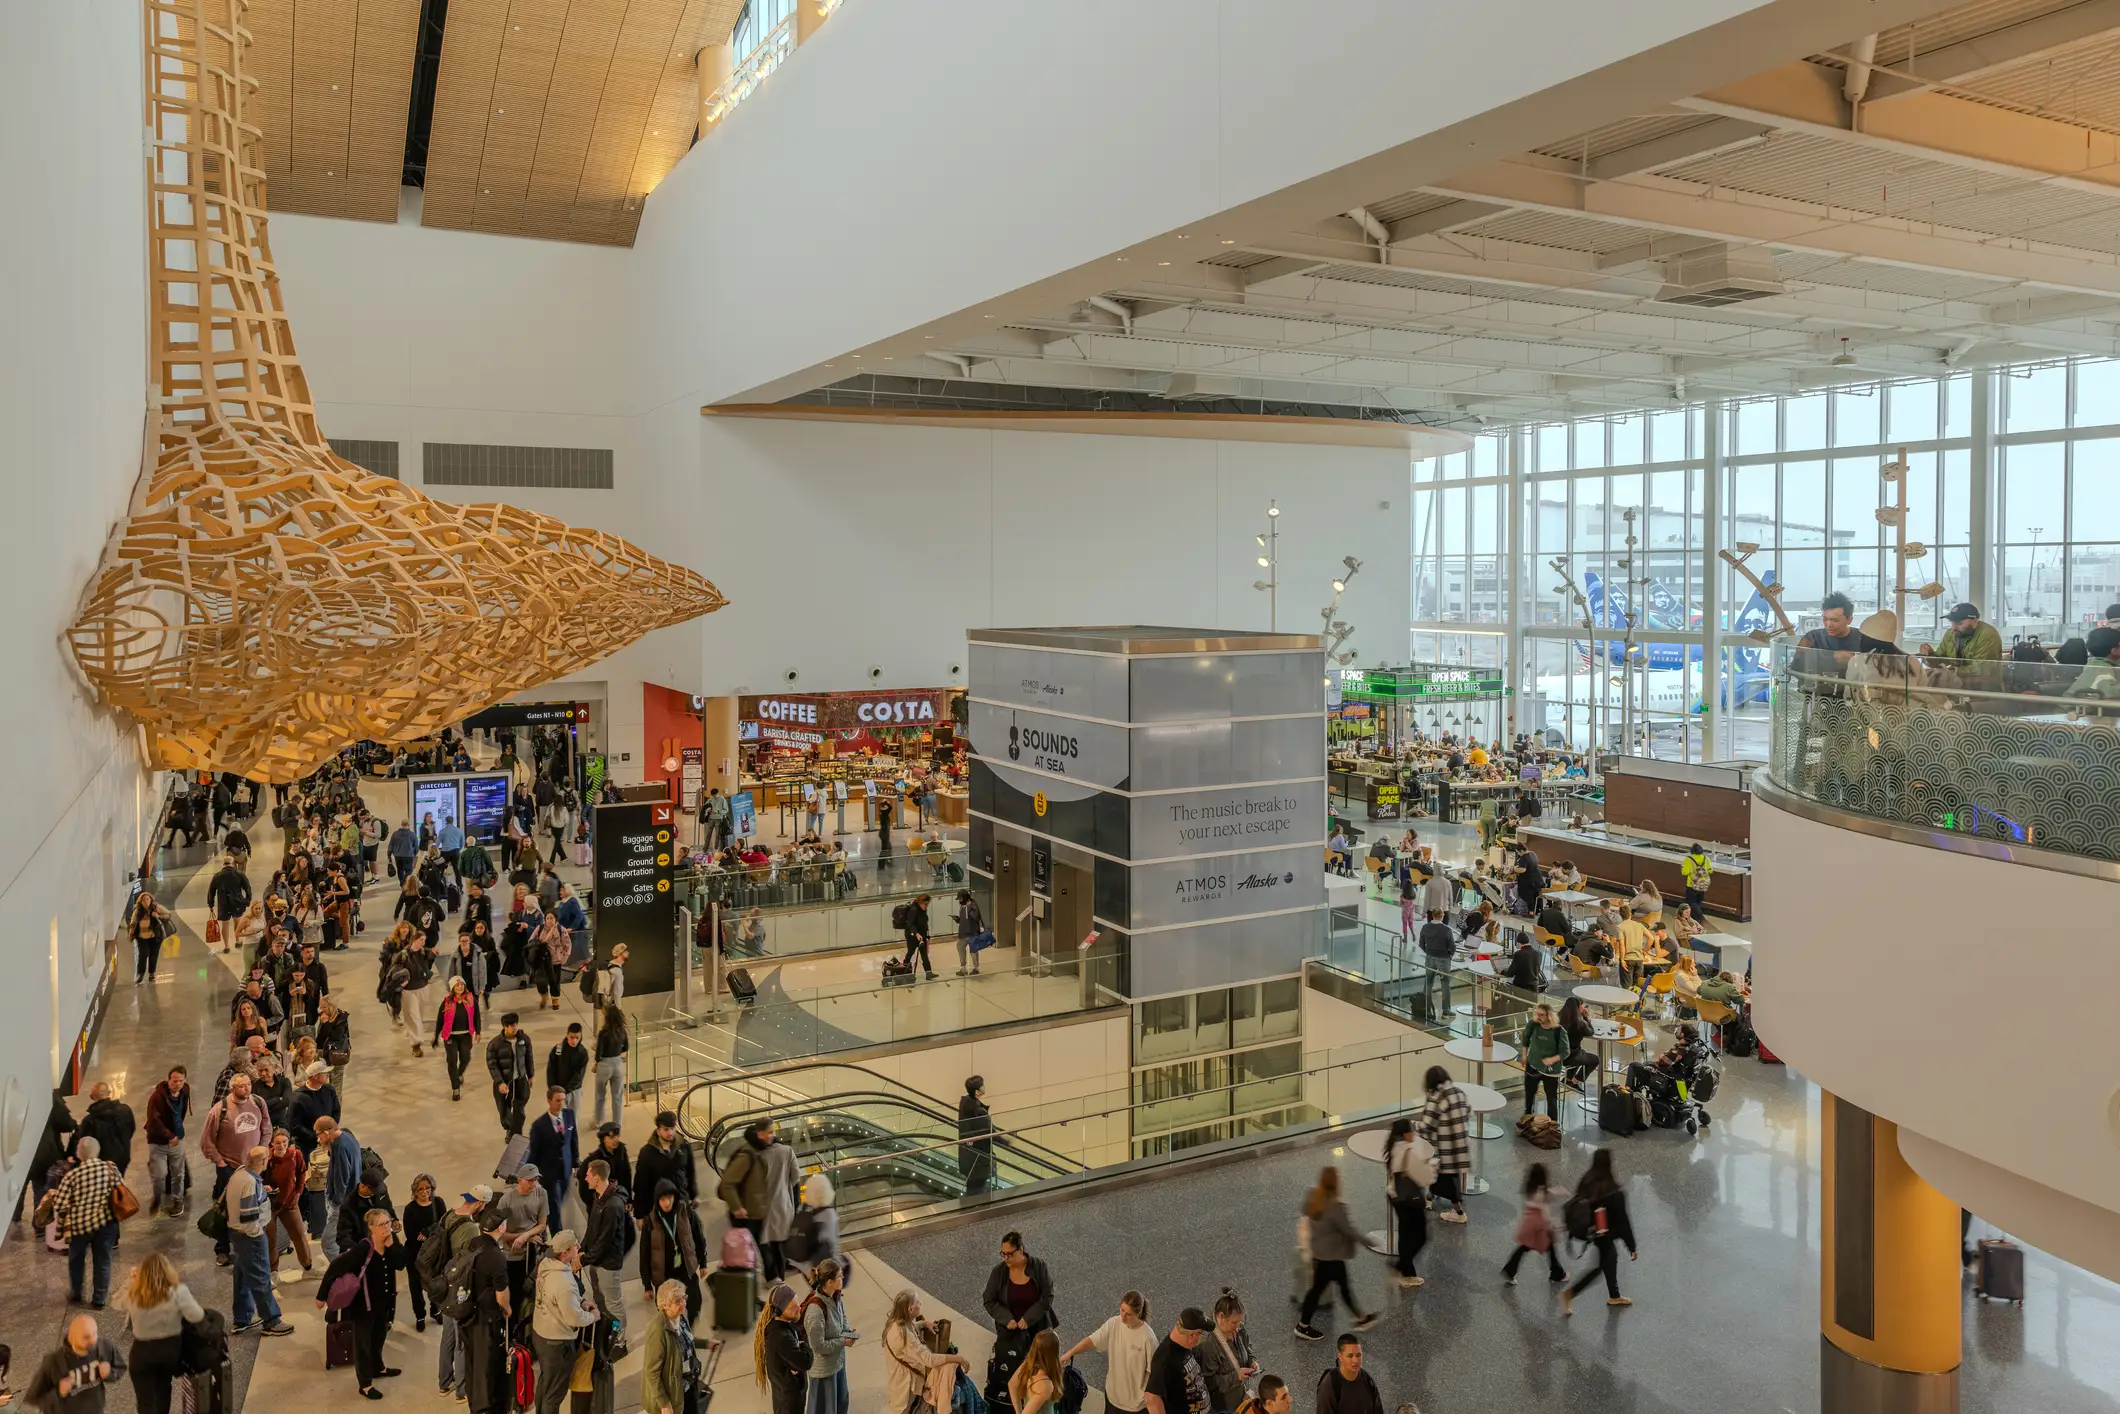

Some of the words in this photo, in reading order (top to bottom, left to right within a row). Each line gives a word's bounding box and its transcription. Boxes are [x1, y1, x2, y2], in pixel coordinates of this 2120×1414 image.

[1346, 670, 1364, 682] SPACE
[1431, 671, 1449, 683] OPEN
[1450, 671, 1470, 682] SPACE
[1021, 679, 1039, 689] ATMOS
[1042, 684, 1058, 694] Alaska
[1357, 683, 1372, 692] BITES
[1423, 684, 1441, 693] FRESH
[1442, 683, 1457, 692] BEER
[1458, 683, 1463, 691] &
[1464, 682, 1480, 691] BITES
[759, 699, 817, 723] COFFEE
[857, 700, 934, 722] COSTA
[763, 728, 789, 739] BARISTA
[790, 731, 822, 743] CRAFTED
[774, 739, 791, 748] DRINKS
[1023, 728, 1078, 758] SOUNDS
[1034, 756, 1044, 768] AT
[1047, 758, 1065, 773] SEA
[1379, 786, 1398, 794] OPEN
[1377, 795, 1399, 804] SPACE
[1170, 804, 1198, 821] The
[1201, 801, 1242, 819] music
[1245, 797, 1282, 815] break
[1284, 798, 1297, 810] to
[1377, 808, 1397, 818] Room
[1179, 827, 1210, 845] your
[1213, 822, 1242, 837] next
[1245, 818, 1290, 834] escape
[622, 835, 654, 845] Baggage
[633, 844, 654, 853] Claim
[627, 857, 654, 867] Ground
[603, 868, 654, 879] Transportation
[1175, 875, 1226, 894] ATMOS
[1237, 873, 1278, 890] Alaska
[633, 884, 654, 892] Gates
[1182, 892, 1222, 903] REWARDS
